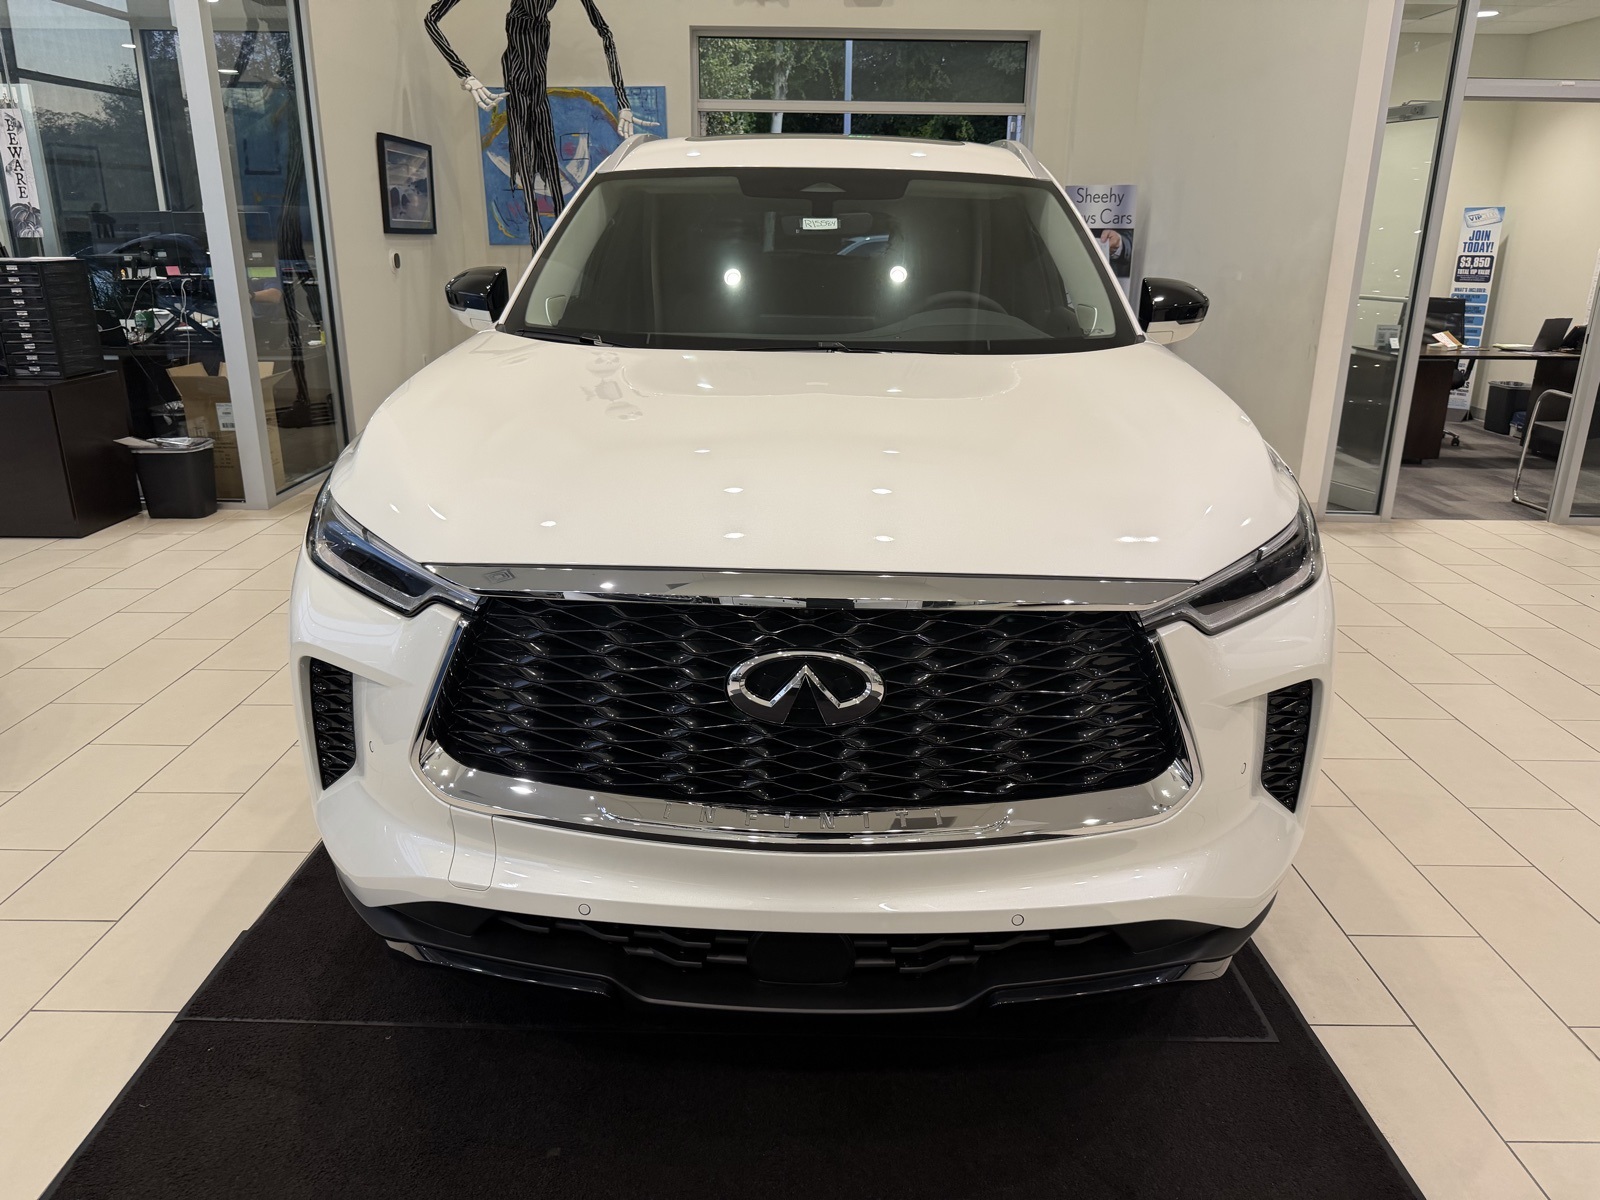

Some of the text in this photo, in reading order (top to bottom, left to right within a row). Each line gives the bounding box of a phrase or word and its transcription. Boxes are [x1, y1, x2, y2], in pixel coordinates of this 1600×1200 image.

[4, 118, 29, 199] BEWARE
[1076, 187, 1125, 207] Sheehy
[1099, 208, 1133, 225] Cars
[1469, 230, 1491, 241] JOIN
[1463, 242, 1494, 253] TODAY!
[1460, 256, 1491, 268] $3,850
[662, 801, 944, 830] INFINITI
